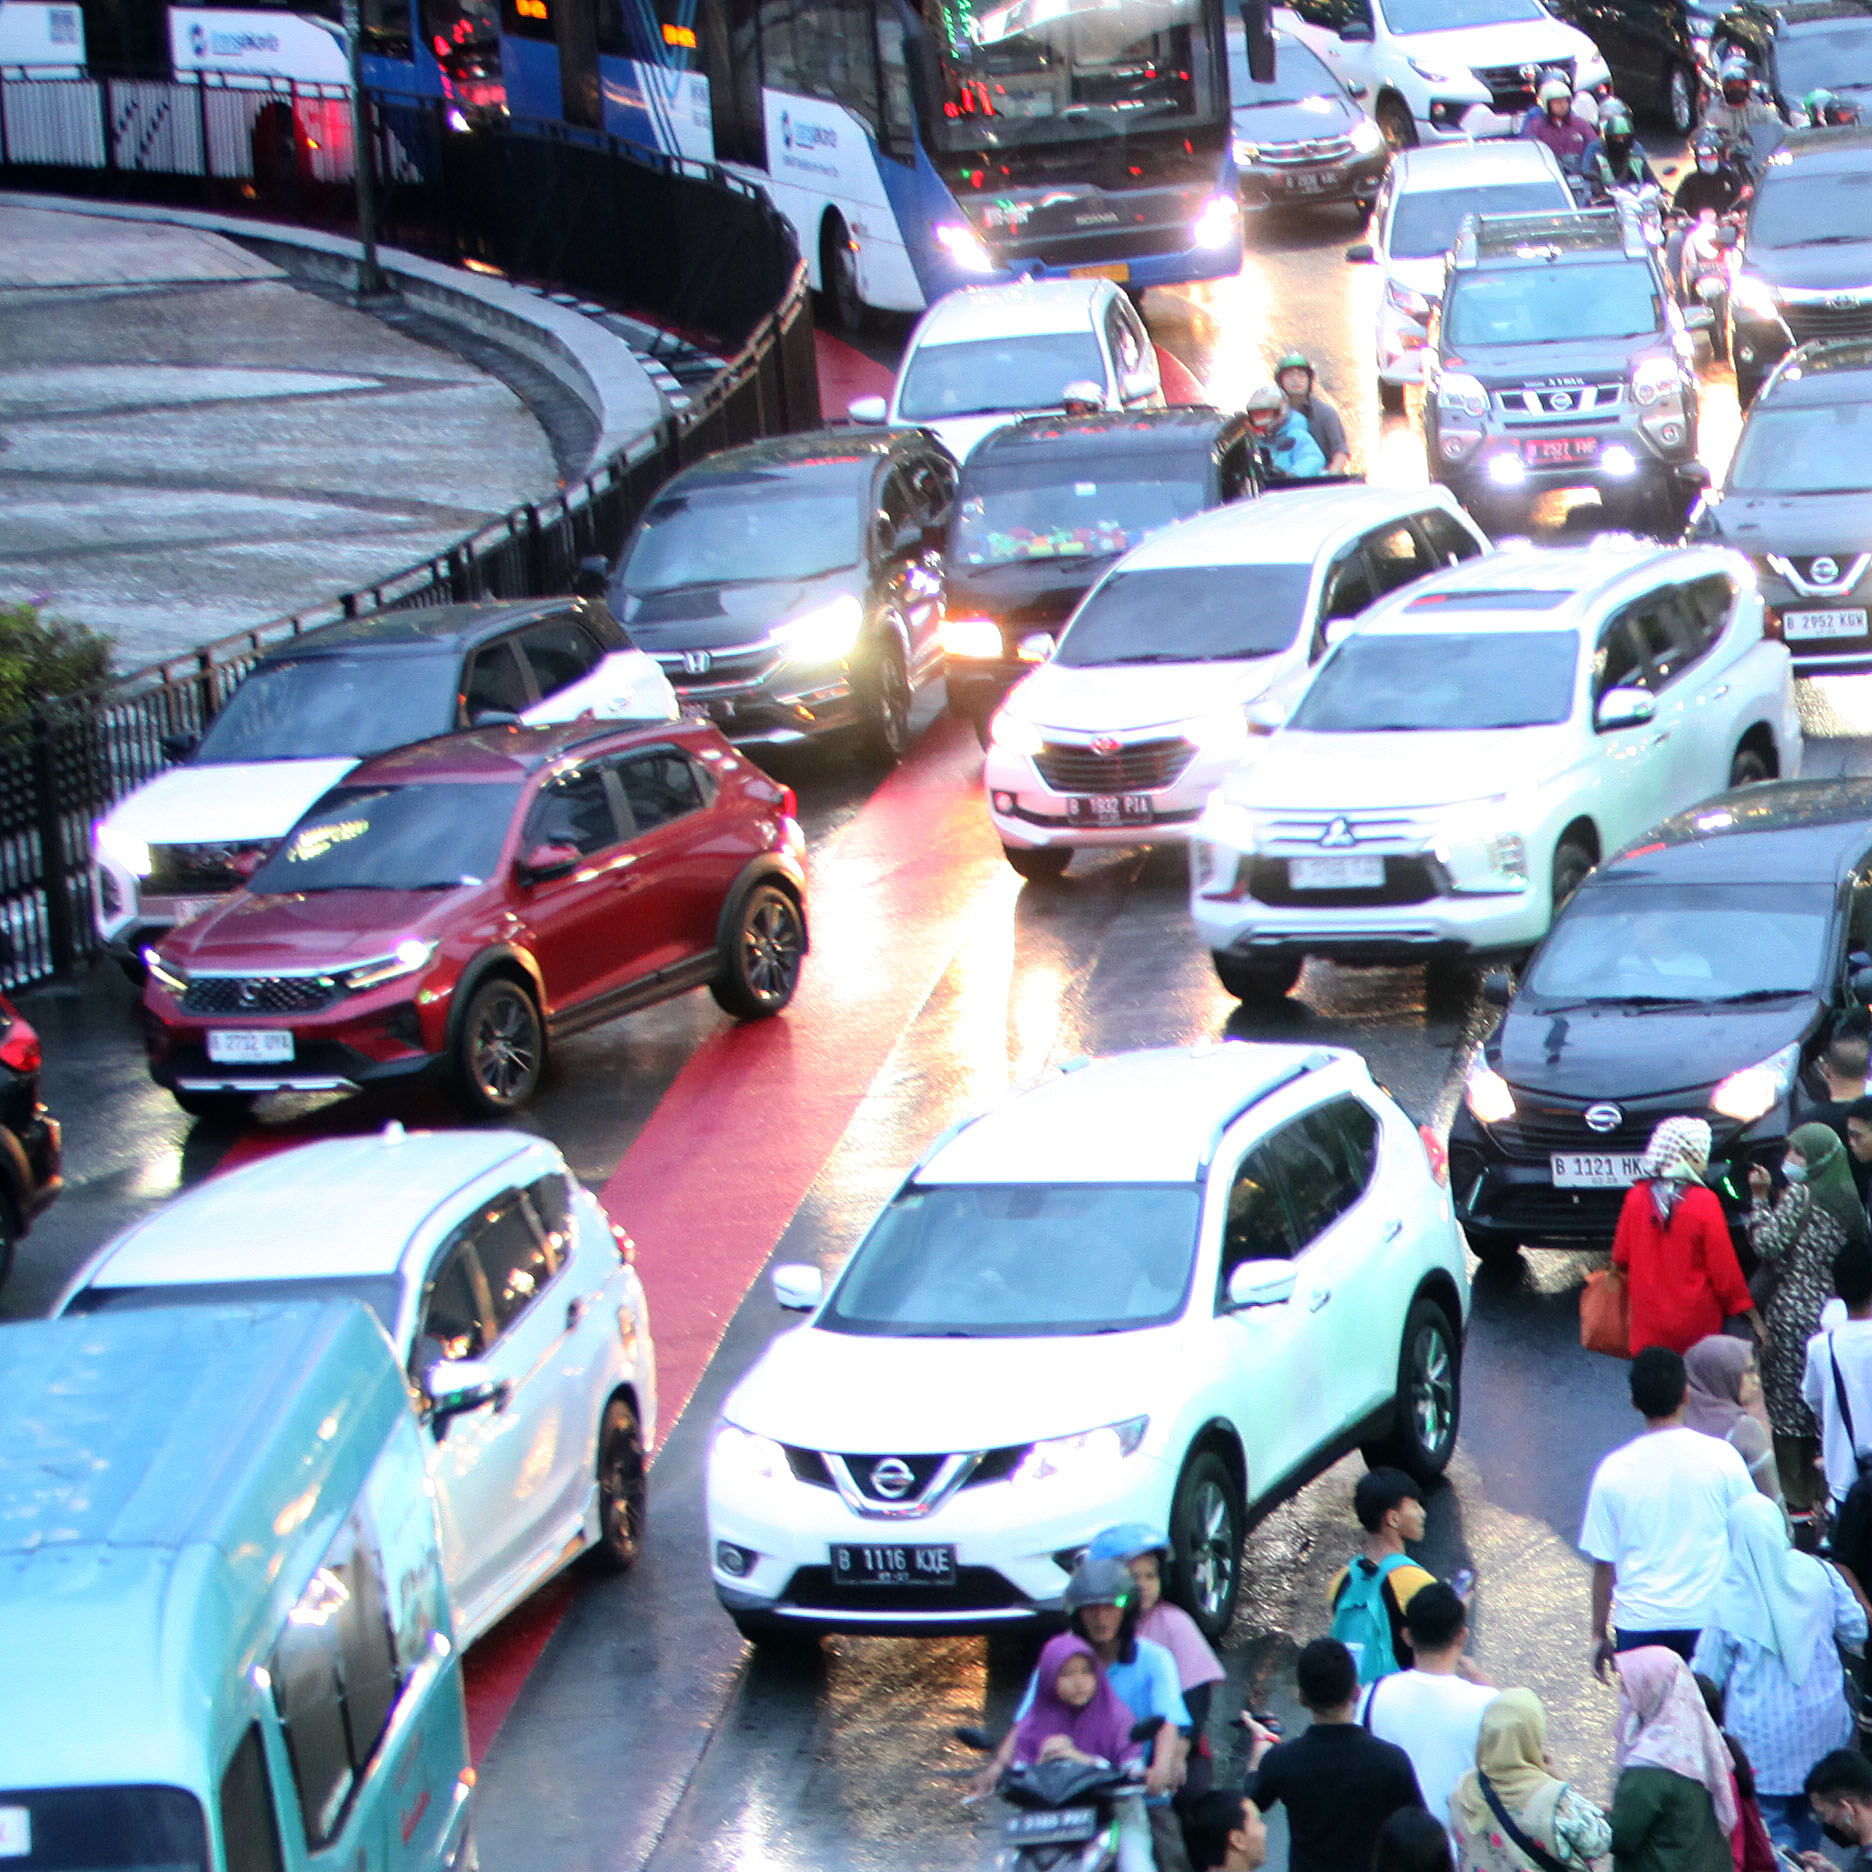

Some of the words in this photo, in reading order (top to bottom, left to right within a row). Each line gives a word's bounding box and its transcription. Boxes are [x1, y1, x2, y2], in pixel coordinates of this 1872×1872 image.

[1786, 617, 1795, 630] B
[1555, 1159, 1566, 1176] B
[1574, 1158, 1614, 1177] 1121
[1622, 1158, 1650, 1177] HK
[839, 1548, 851, 1571] B
